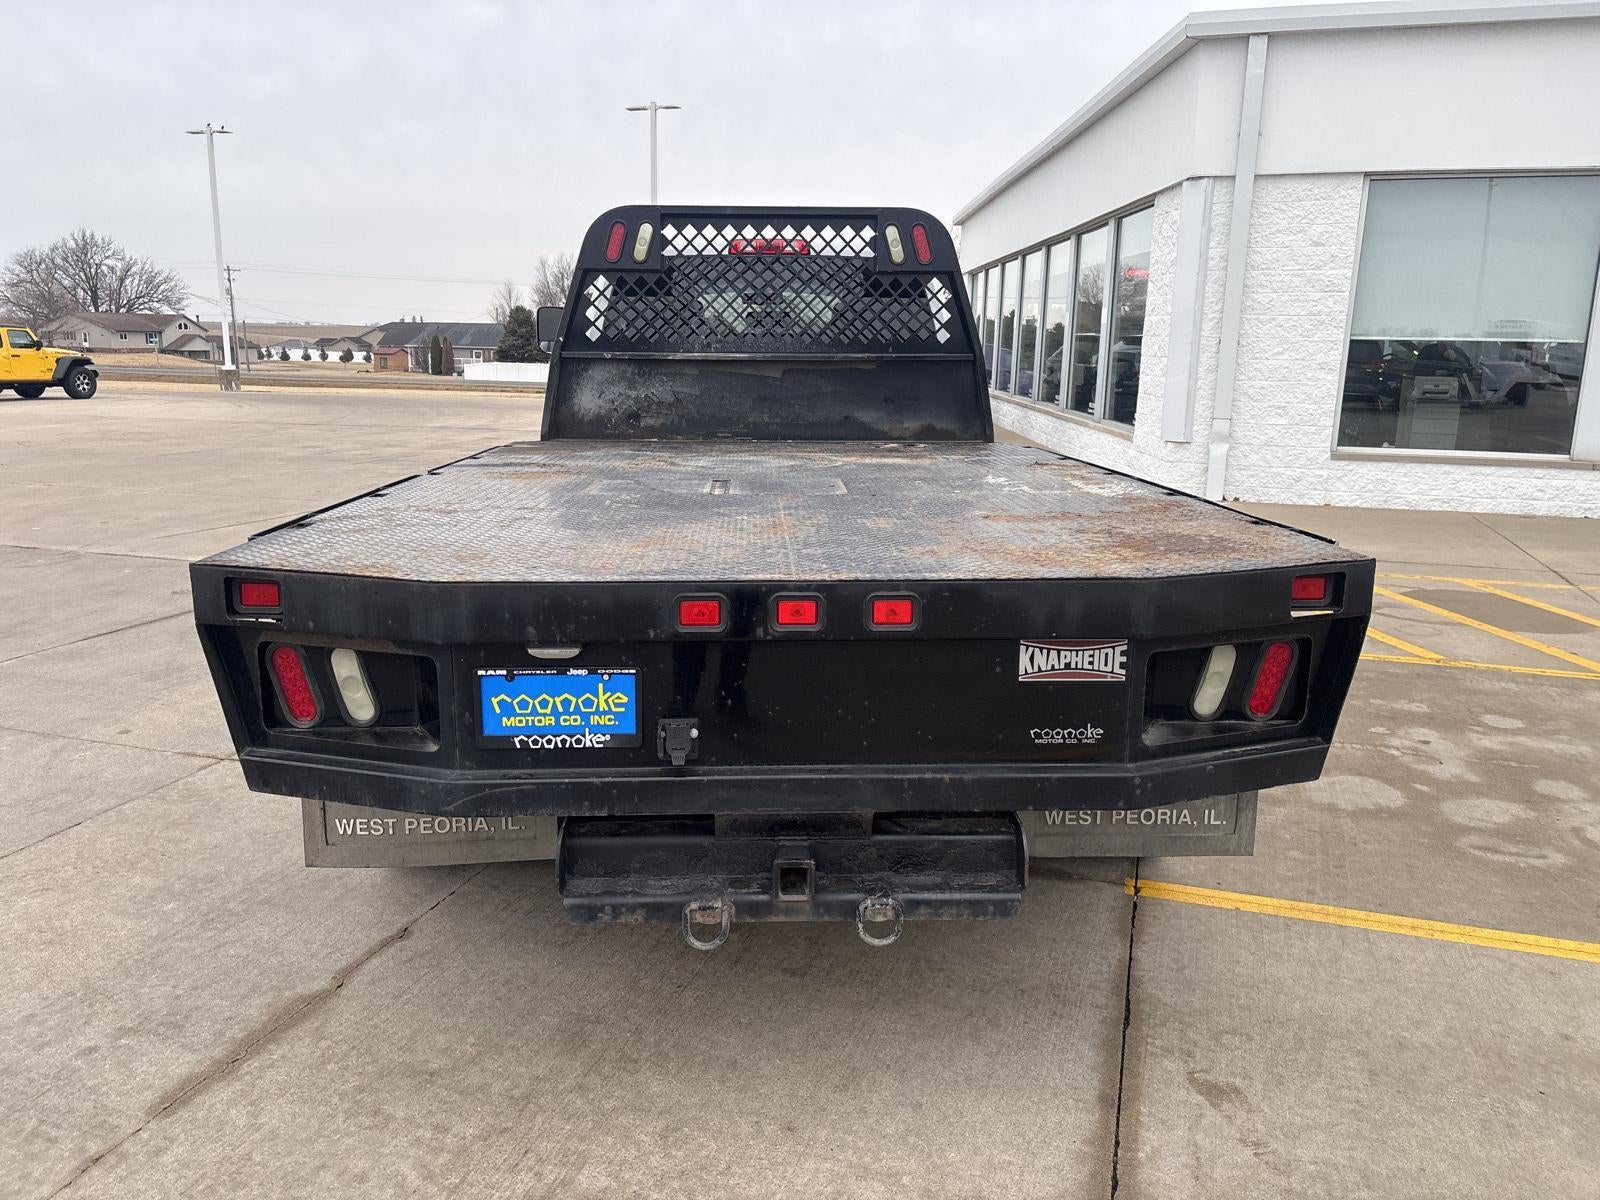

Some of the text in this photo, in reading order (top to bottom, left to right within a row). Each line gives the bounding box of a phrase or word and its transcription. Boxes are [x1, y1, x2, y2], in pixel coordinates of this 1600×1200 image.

[1019, 644, 1128, 675] KNAPHEIDE
[566, 668, 589, 676] Jeep
[502, 715, 619, 727] MOTOR CO. INC.
[335, 816, 526, 836] WEST PEORIA, IL.
[1045, 809, 1227, 828] WEST PEORIA, IL.
